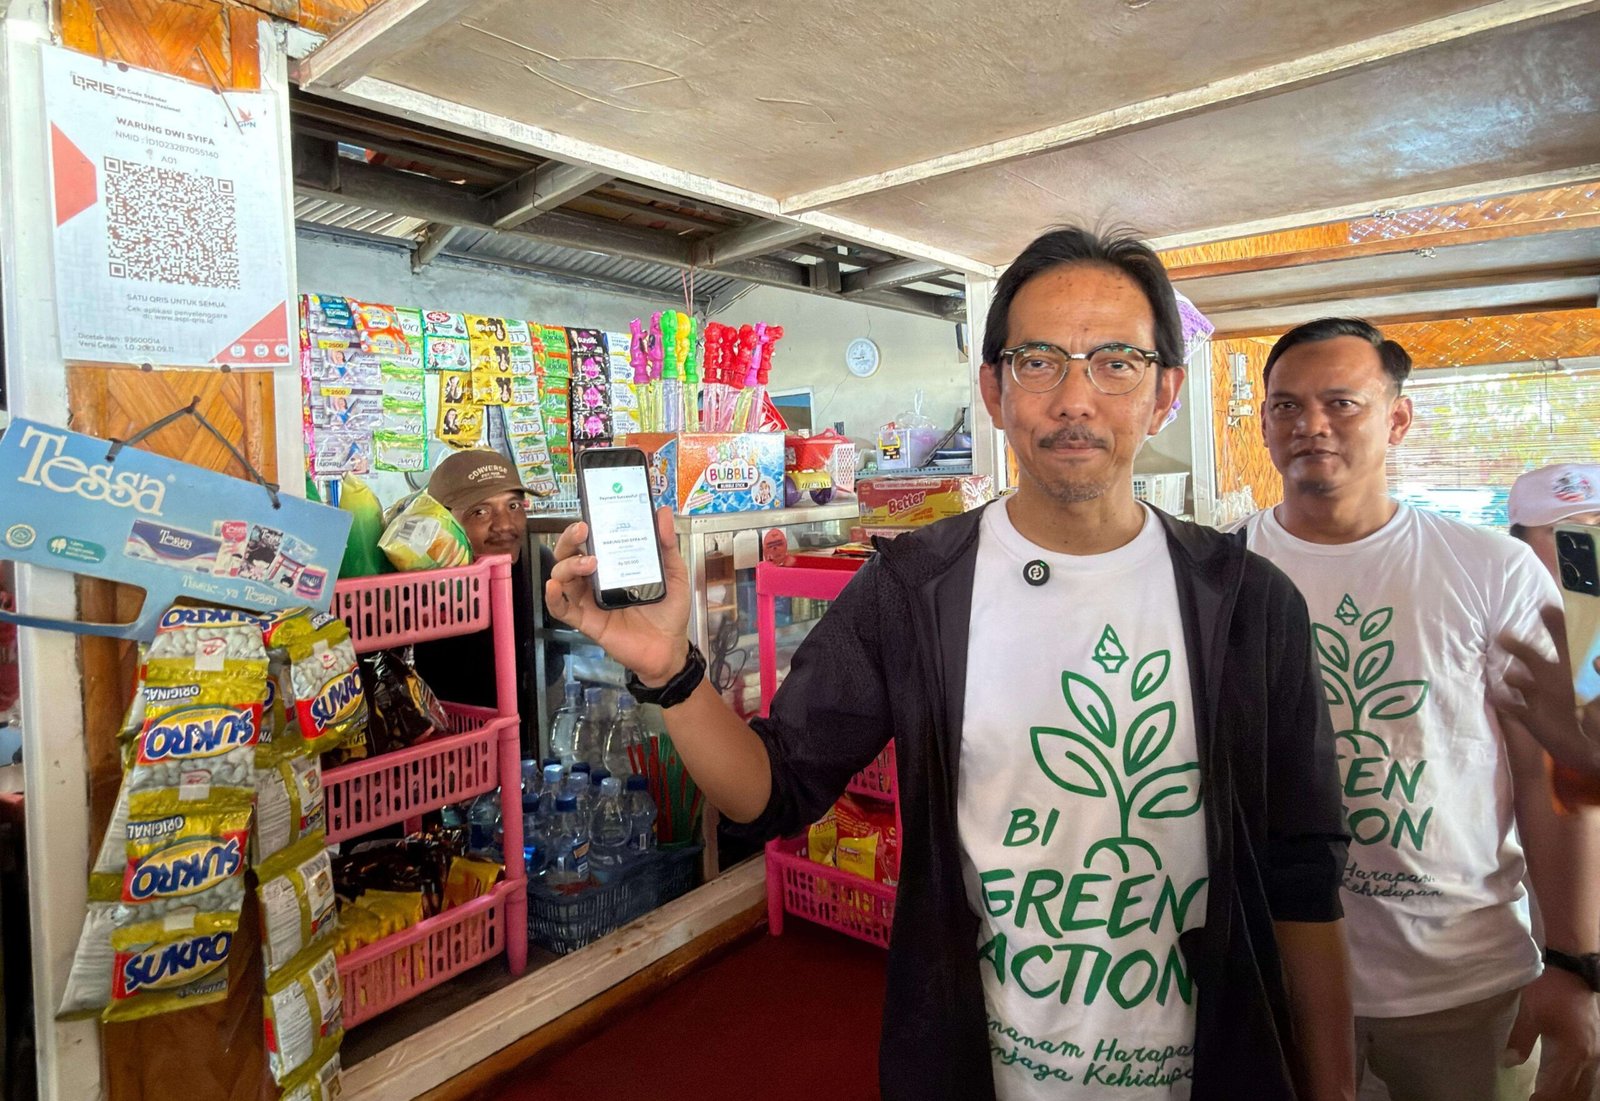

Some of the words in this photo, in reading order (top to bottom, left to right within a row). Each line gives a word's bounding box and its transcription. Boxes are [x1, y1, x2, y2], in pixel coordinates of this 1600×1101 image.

[72, 74, 116, 96] QRIS
[115, 130, 140, 142] NMID
[116, 117, 162, 135] WARUNG
[164, 128, 186, 140] DWI
[186, 132, 216, 147] SYIFA
[161, 156, 178, 164] A01
[149, 296, 169, 304] QRIS
[170, 298, 198, 306] UNTUK
[198, 300, 226, 308] SEMUA
[511, 422, 542, 434] CLEAR
[519, 452, 550, 464] CLEAR
[18, 426, 166, 516] Tessa
[468, 465, 508, 480] CONVERSE
[710, 468, 754, 480] BUBBLE
[888, 491, 926, 516] Better
[160, 528, 193, 550] Tessa
[145, 708, 255, 760] SUKRO
[126, 815, 185, 841] ORIGINAL
[1002, 807, 1060, 846] BI
[130, 838, 241, 900] SUKRO
[980, 868, 1209, 939] GREEN
[124, 932, 233, 994] SUKRO
[979, 932, 1193, 1010] ACTION
